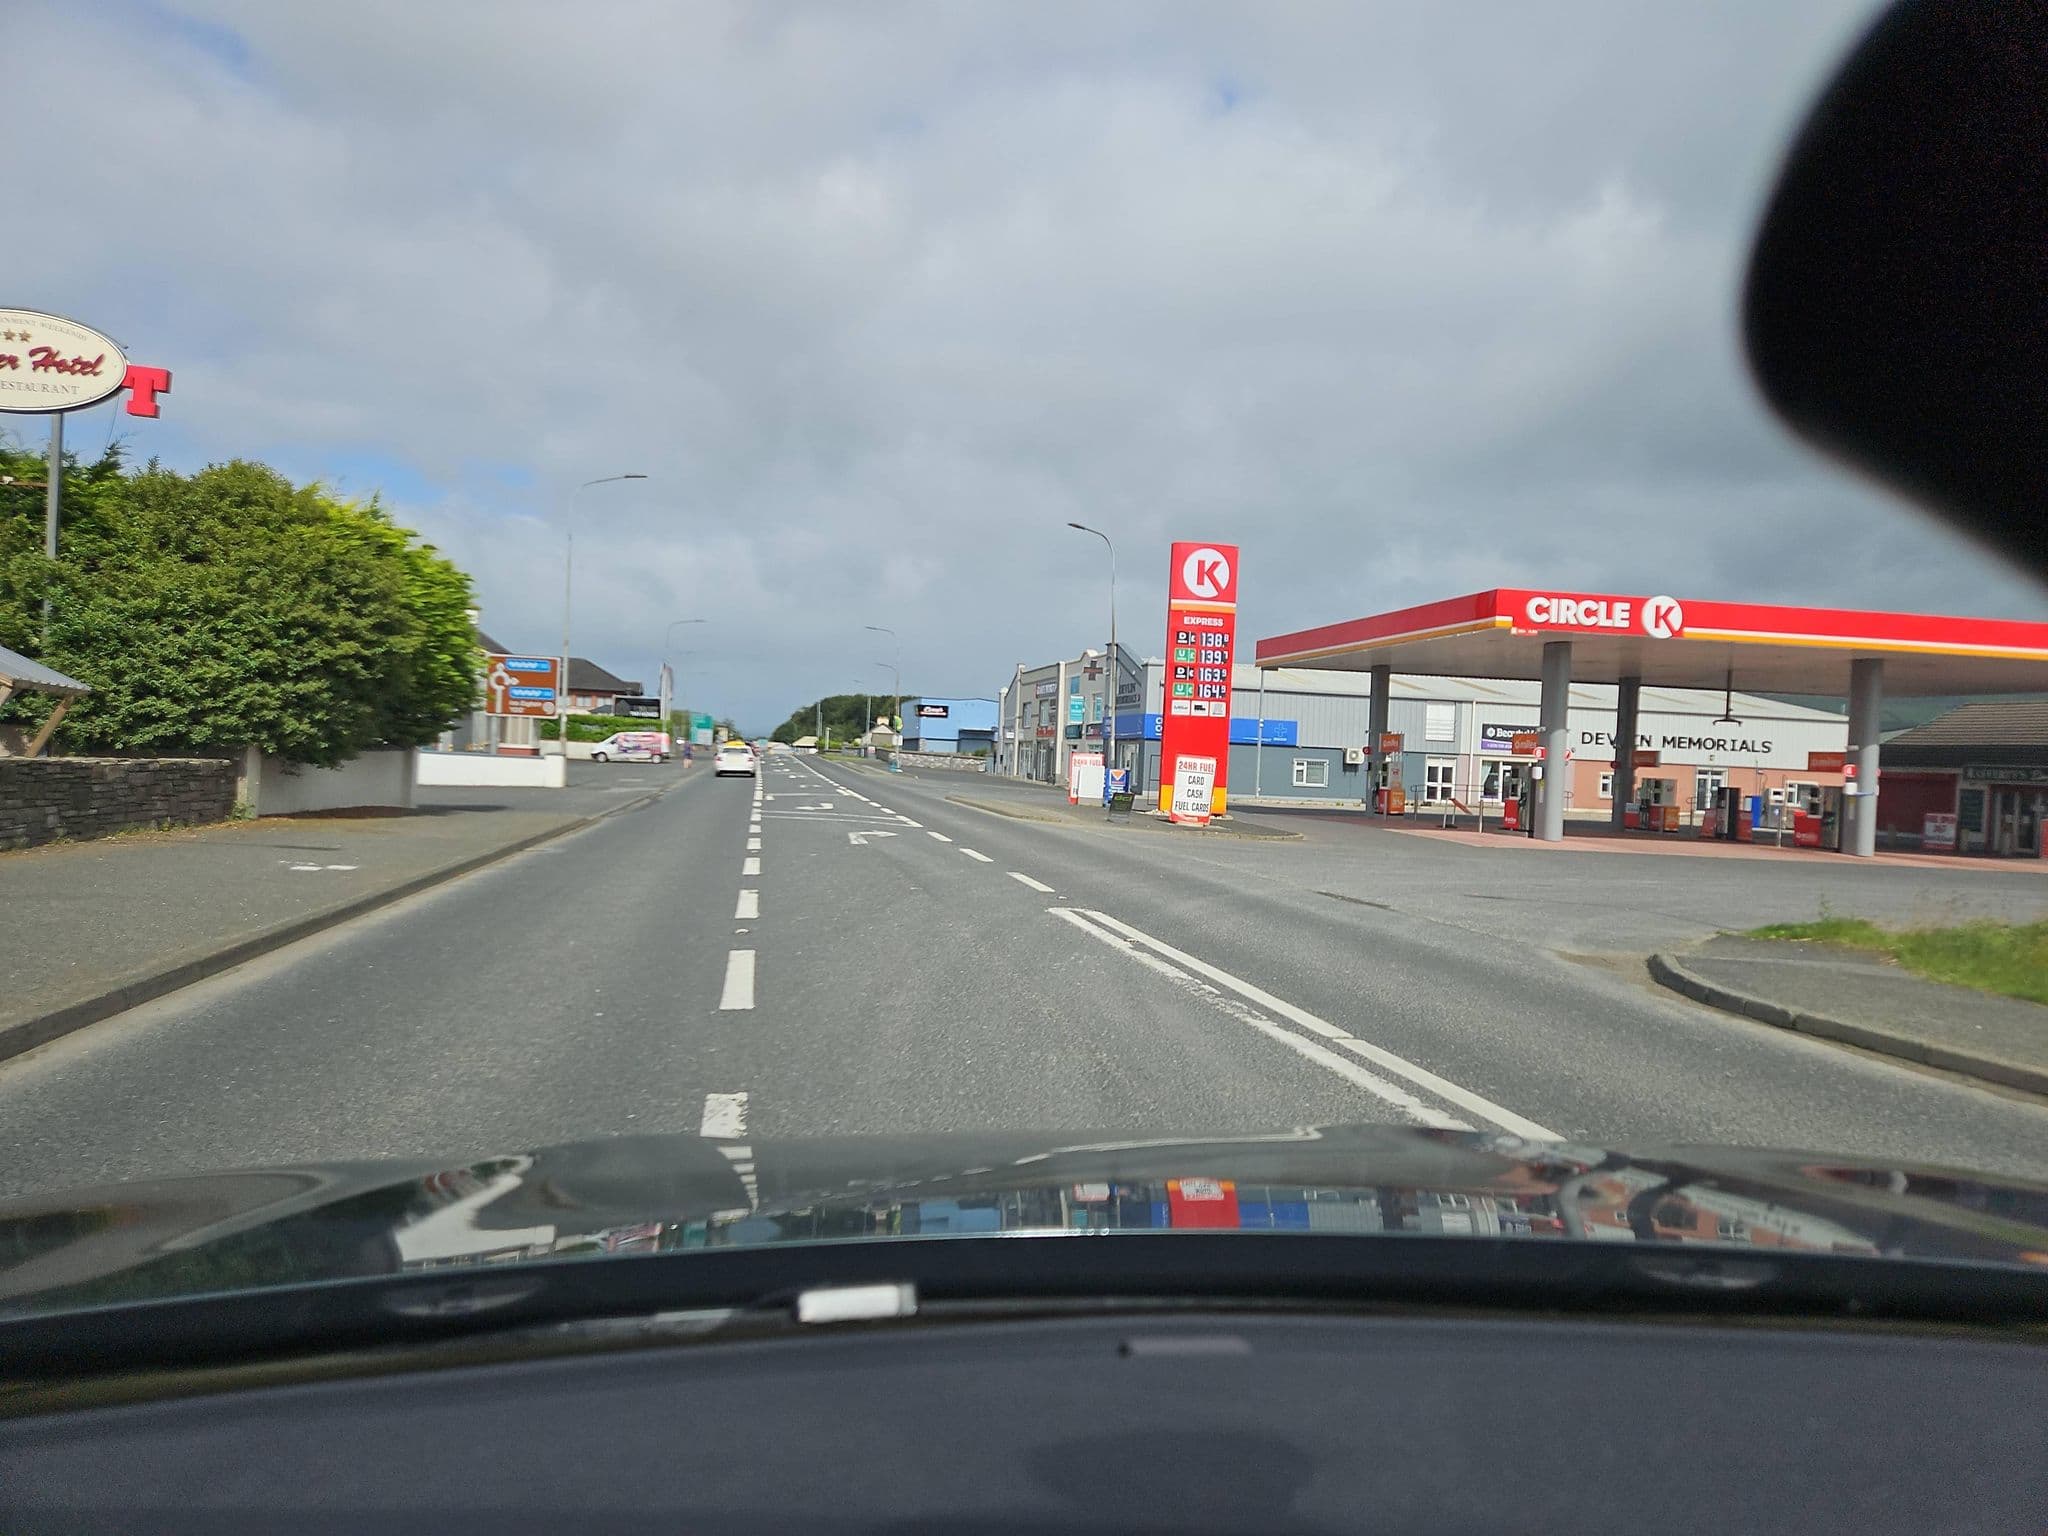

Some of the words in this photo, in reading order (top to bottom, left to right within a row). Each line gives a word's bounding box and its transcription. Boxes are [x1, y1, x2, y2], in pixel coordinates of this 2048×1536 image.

[28, 346, 105, 376] Hotel
[1526, 596, 1631, 628] CIRCLE
[1183, 616, 1224, 627] EXPRESS
[1581, 731, 1652, 747] DEVIN
[1662, 735, 1773, 753] MEMORIALS
[1178, 761, 1198, 771] 24HR
[1200, 763, 1214, 773] FUEL
[1188, 776, 1205, 786] CARD
[1187, 789, 1204, 799] CASH
[1175, 801, 1190, 811] FUEL
[1191, 802, 1209, 812] CARDS
